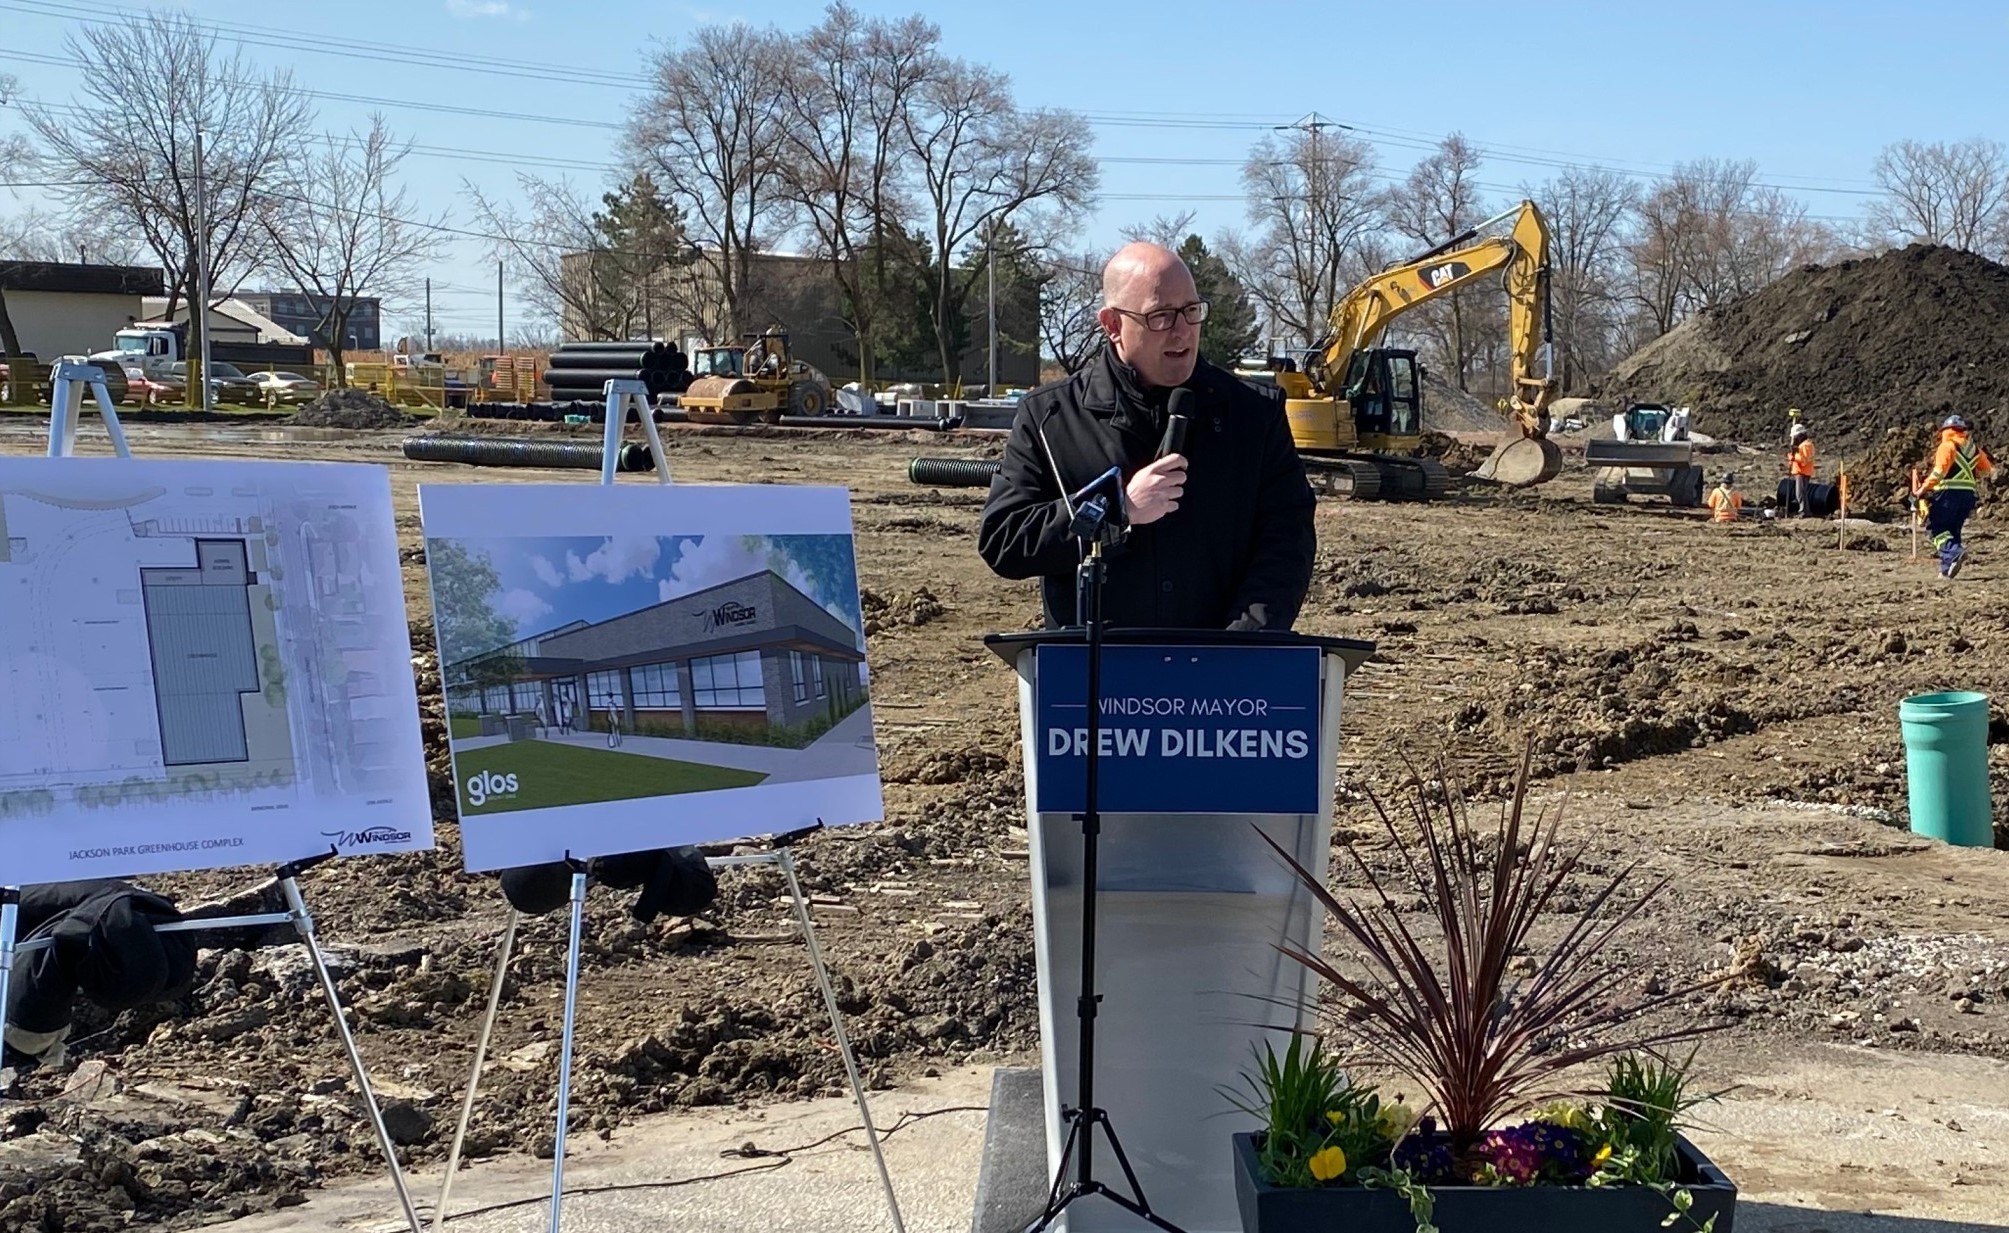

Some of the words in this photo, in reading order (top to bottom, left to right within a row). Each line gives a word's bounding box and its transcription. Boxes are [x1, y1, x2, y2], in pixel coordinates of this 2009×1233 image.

[1431, 263, 1454, 287] CAT
[1190, 698, 1268, 716] MAYOR
[1048, 728, 1151, 757] DREW
[1161, 728, 1309, 759] DILKENS
[466, 770, 519, 806] glos
[69, 848, 110, 860] JACKSON
[112, 846, 136, 856] PARK
[137, 840, 199, 855] GREENHOUSE
[201, 837, 244, 850] COMPLEX
[355, 831, 411, 844] WINDSOR
